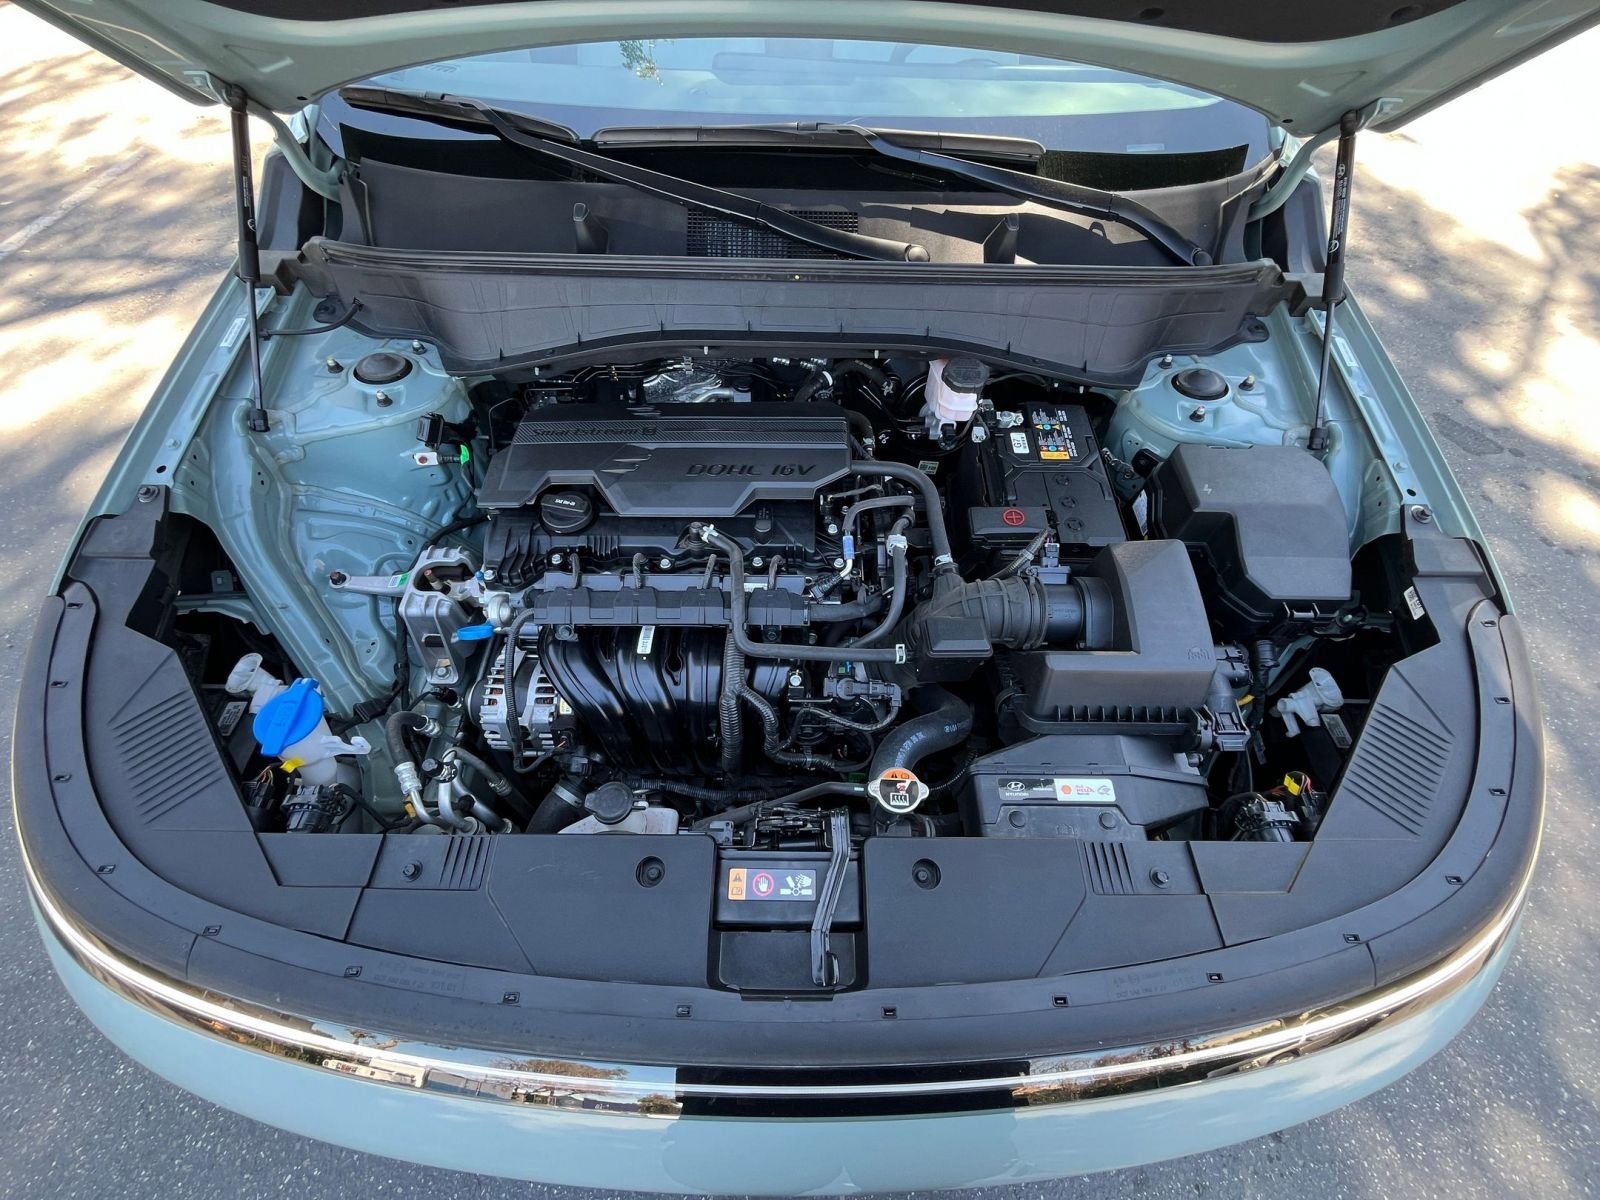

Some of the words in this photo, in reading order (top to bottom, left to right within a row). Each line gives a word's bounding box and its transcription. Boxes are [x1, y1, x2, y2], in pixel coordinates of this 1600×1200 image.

[531, 425, 638, 438] Smartstream
[1013, 438, 1022, 449] G7
[686, 463, 762, 477] DOHC
[770, 463, 817, 477] 16V
